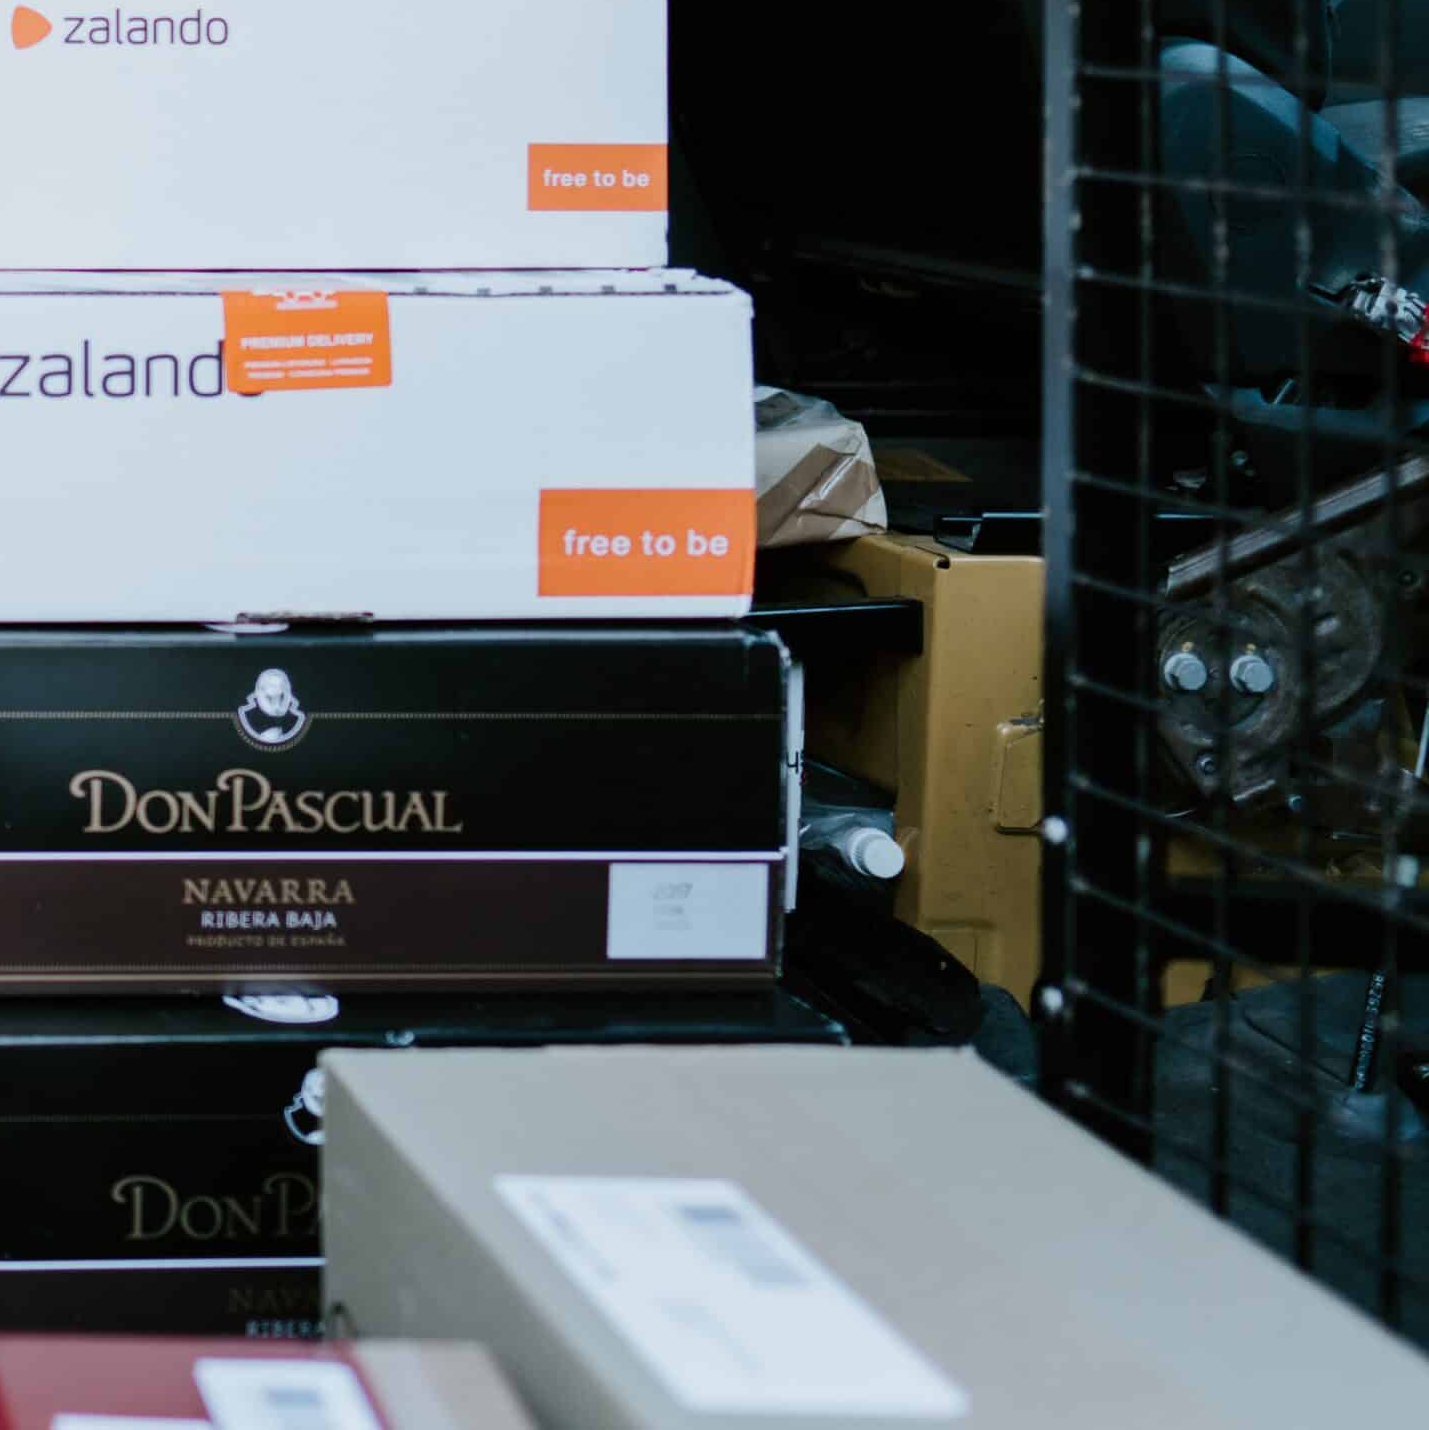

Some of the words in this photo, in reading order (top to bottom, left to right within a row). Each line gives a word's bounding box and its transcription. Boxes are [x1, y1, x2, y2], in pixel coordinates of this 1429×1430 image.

[62, 6, 230, 48] zalando
[541, 168, 586, 188] free
[591, 169, 613, 188] to
[620, 167, 650, 188] be
[562, 526, 631, 558] free
[640, 527, 675, 558] to
[685, 526, 729, 558] be
[181, 878, 357, 905] NAVARRA
[200, 910, 280, 929] RIBERA
[285, 911, 337, 931] BAJA
